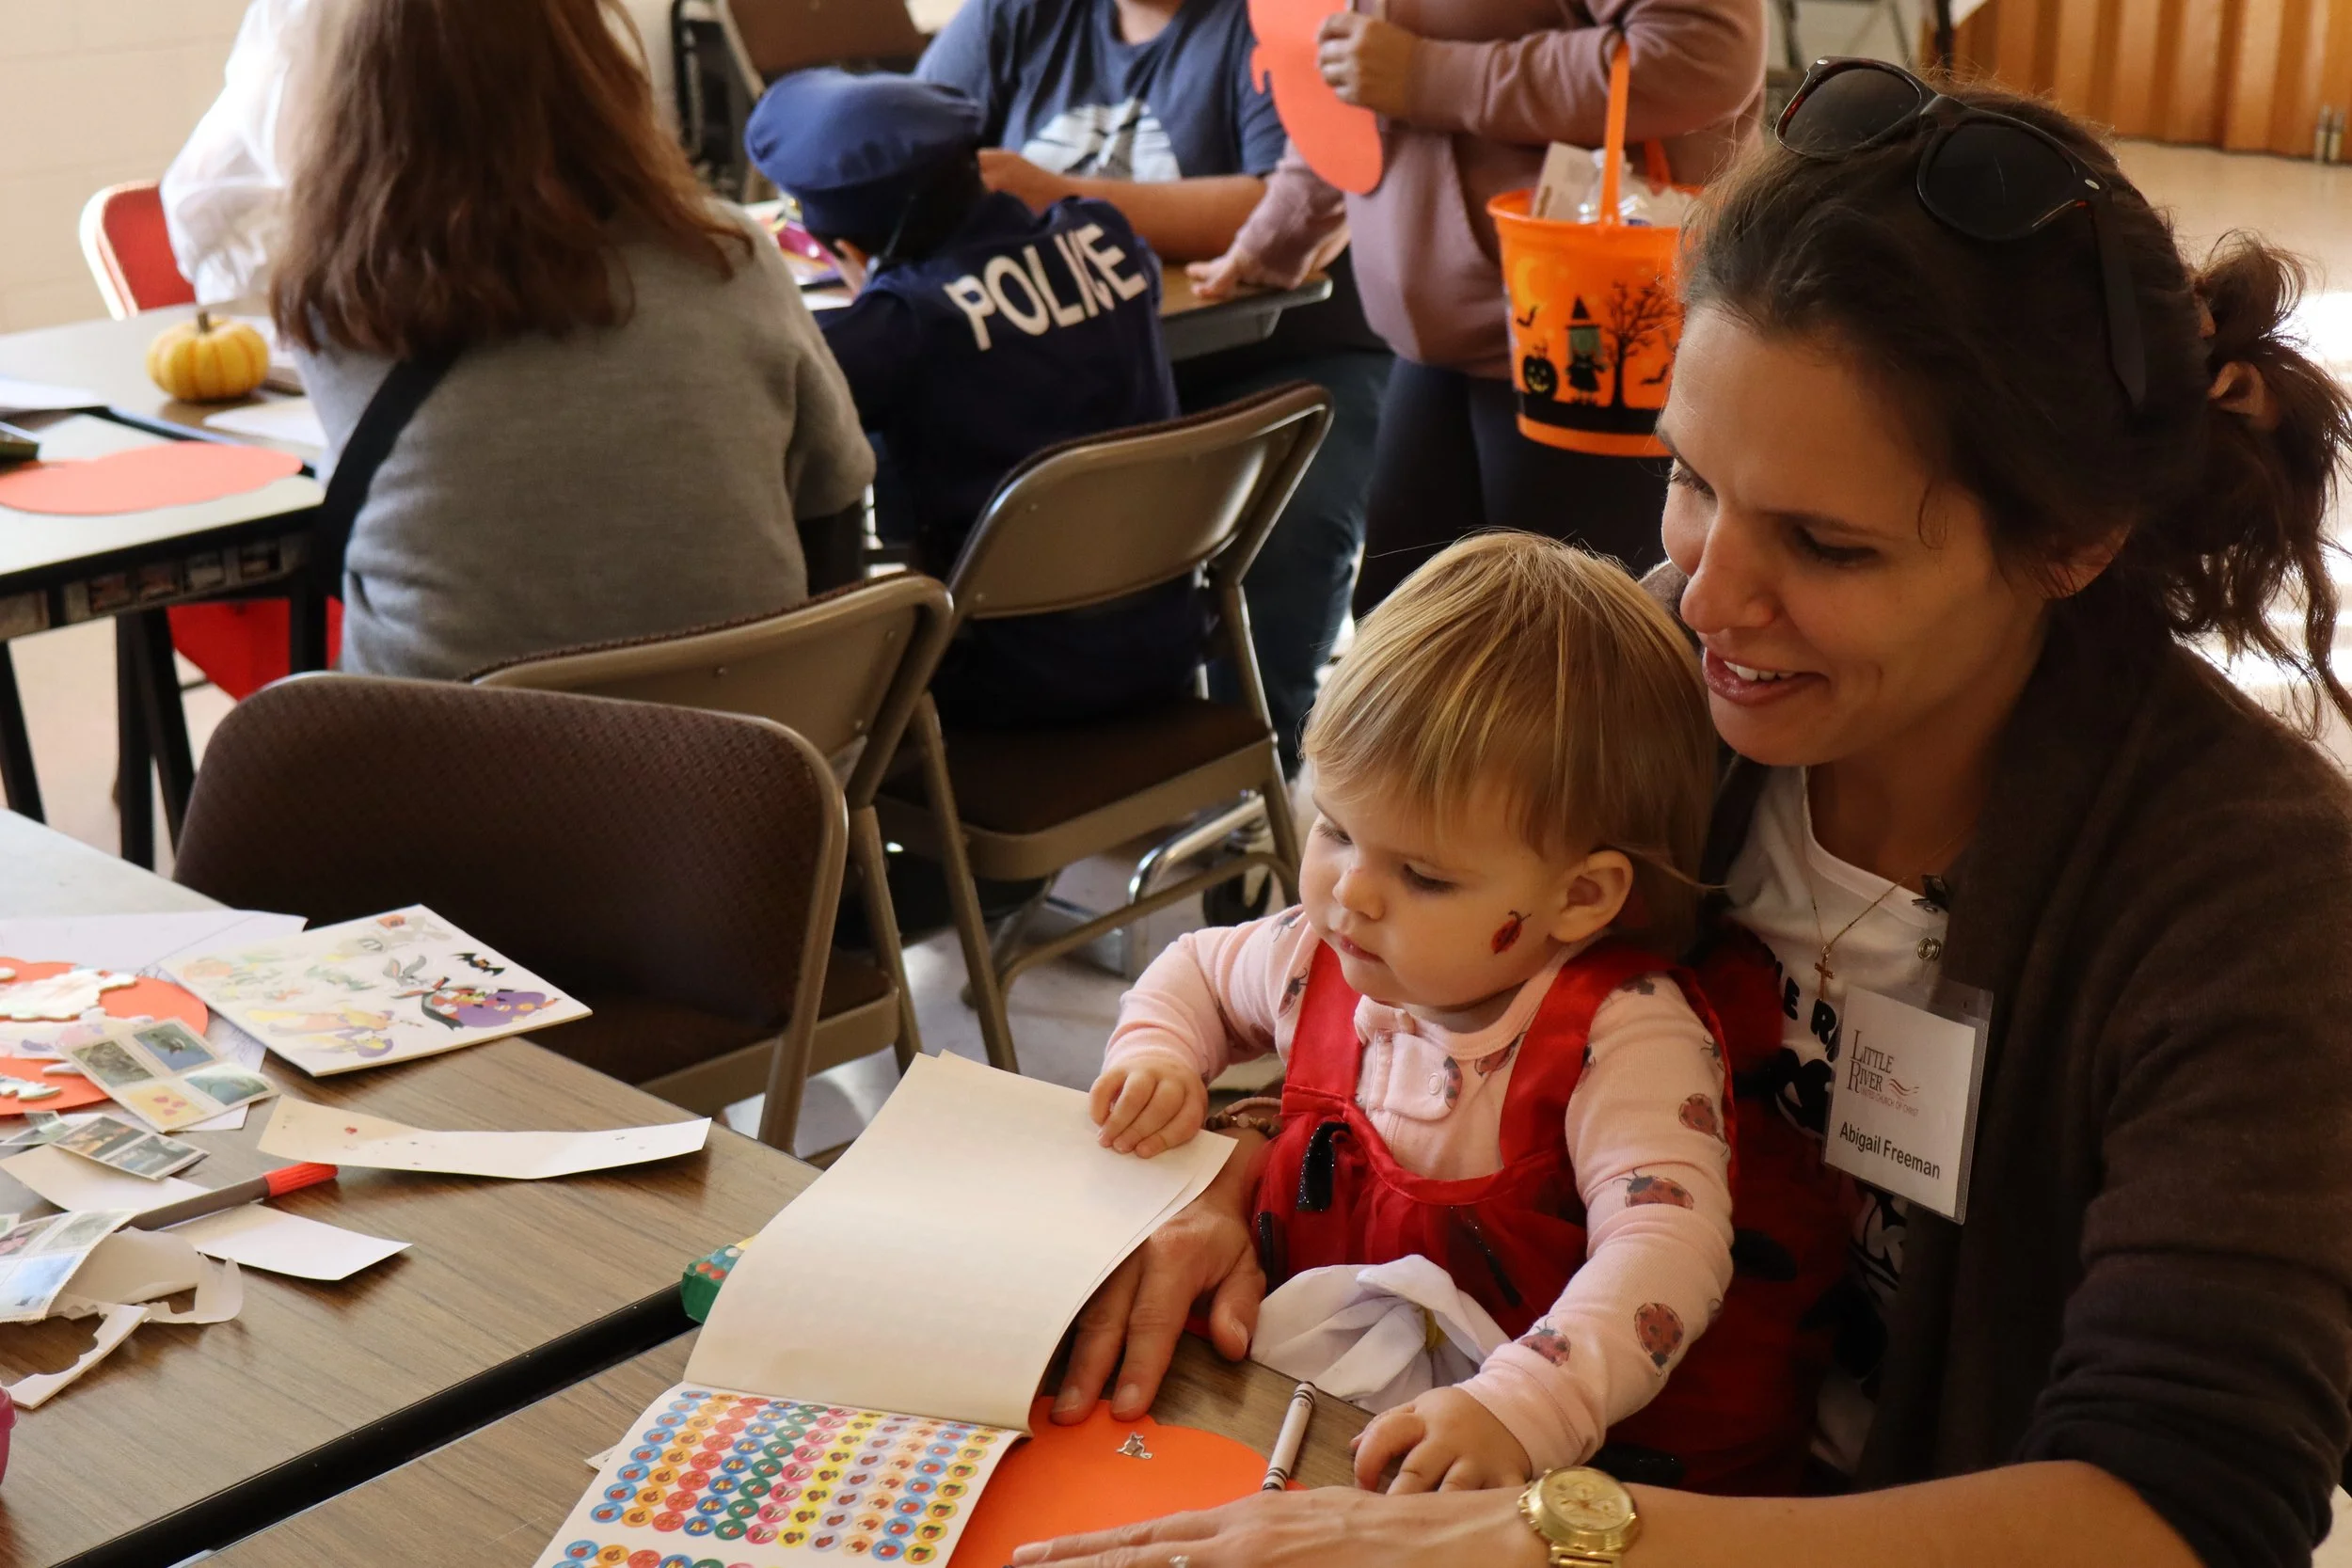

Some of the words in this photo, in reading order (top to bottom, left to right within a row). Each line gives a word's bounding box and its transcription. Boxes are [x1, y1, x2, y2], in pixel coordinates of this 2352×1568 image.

[1850, 1029, 1895, 1074] LITTLE
[1846, 1059, 1883, 1094] RIVER
[1839, 1121, 1881, 1153] Abigail
[1883, 1139, 1941, 1180] Freeman
